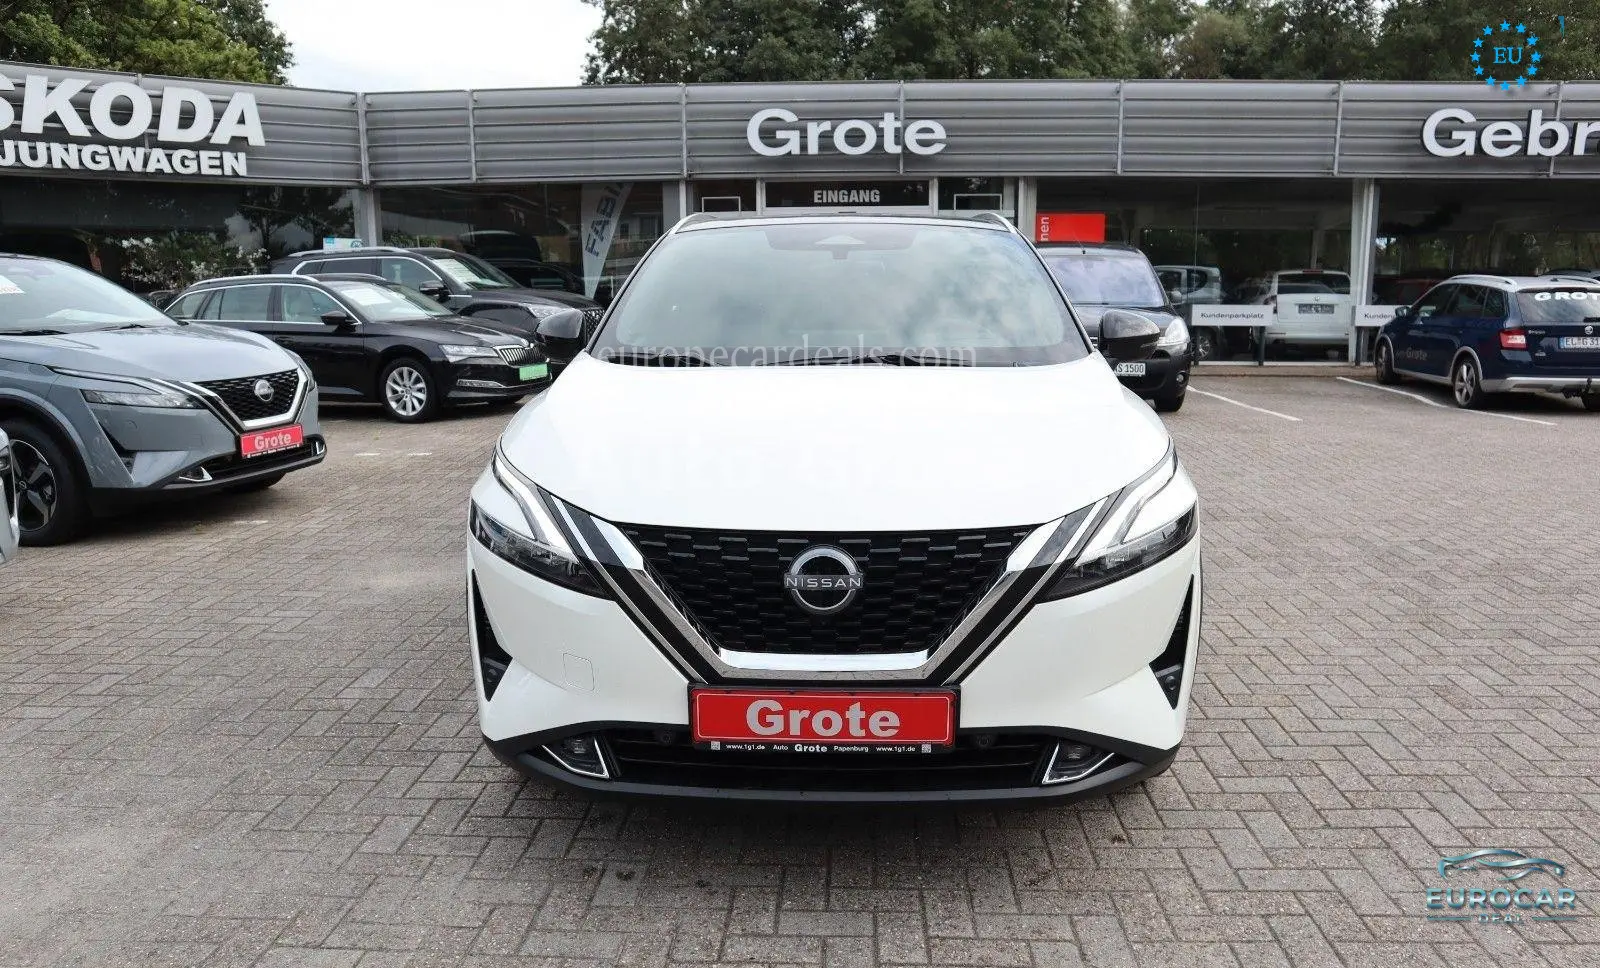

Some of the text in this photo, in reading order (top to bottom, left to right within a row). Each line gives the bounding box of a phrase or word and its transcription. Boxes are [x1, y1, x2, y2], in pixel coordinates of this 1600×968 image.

[746, 107, 948, 157] Grote
[813, 189, 881, 203] EINGANG
[1200, 311, 1265, 320] Kundenparkplatz
[1124, 363, 1145, 374] 1500
[254, 431, 292, 450] Grote
[786, 577, 862, 588] NISSAN
[745, 699, 901, 738] Grote
[794, 743, 828, 753] Grote
[833, 745, 869, 753] Papenburg
[875, 745, 916, 753] www.1g1.de
